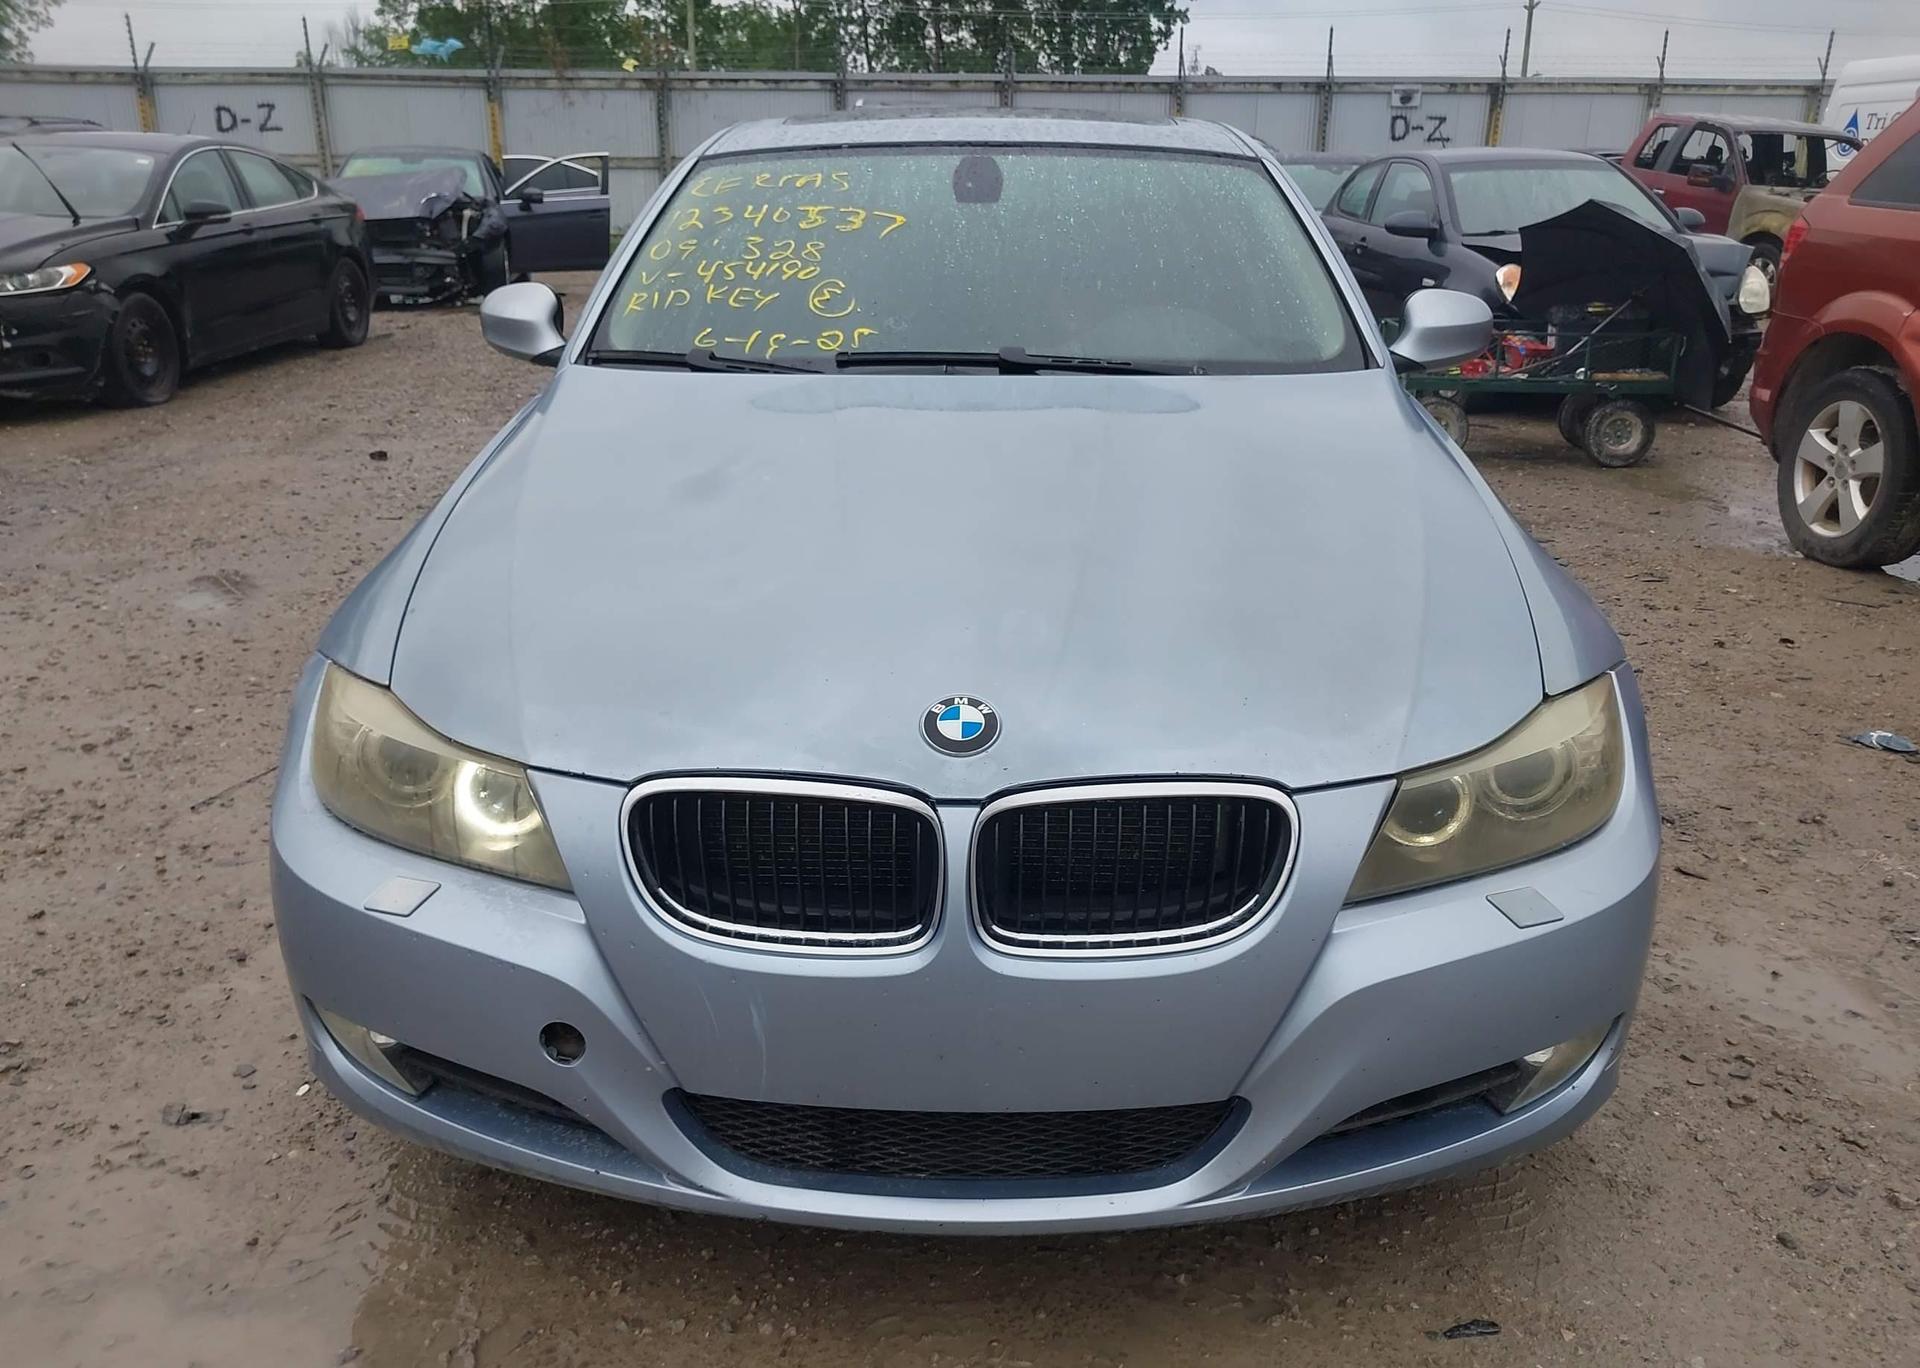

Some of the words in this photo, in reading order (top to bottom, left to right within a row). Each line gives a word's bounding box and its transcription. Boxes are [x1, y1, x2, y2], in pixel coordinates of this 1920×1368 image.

[215, 103, 284, 133] D-Z
[1391, 115, 1450, 145] D-Z
[1866, 112, 1888, 130] Tri
[706, 284, 781, 312] KEY
[931, 697, 993, 714] BMW
